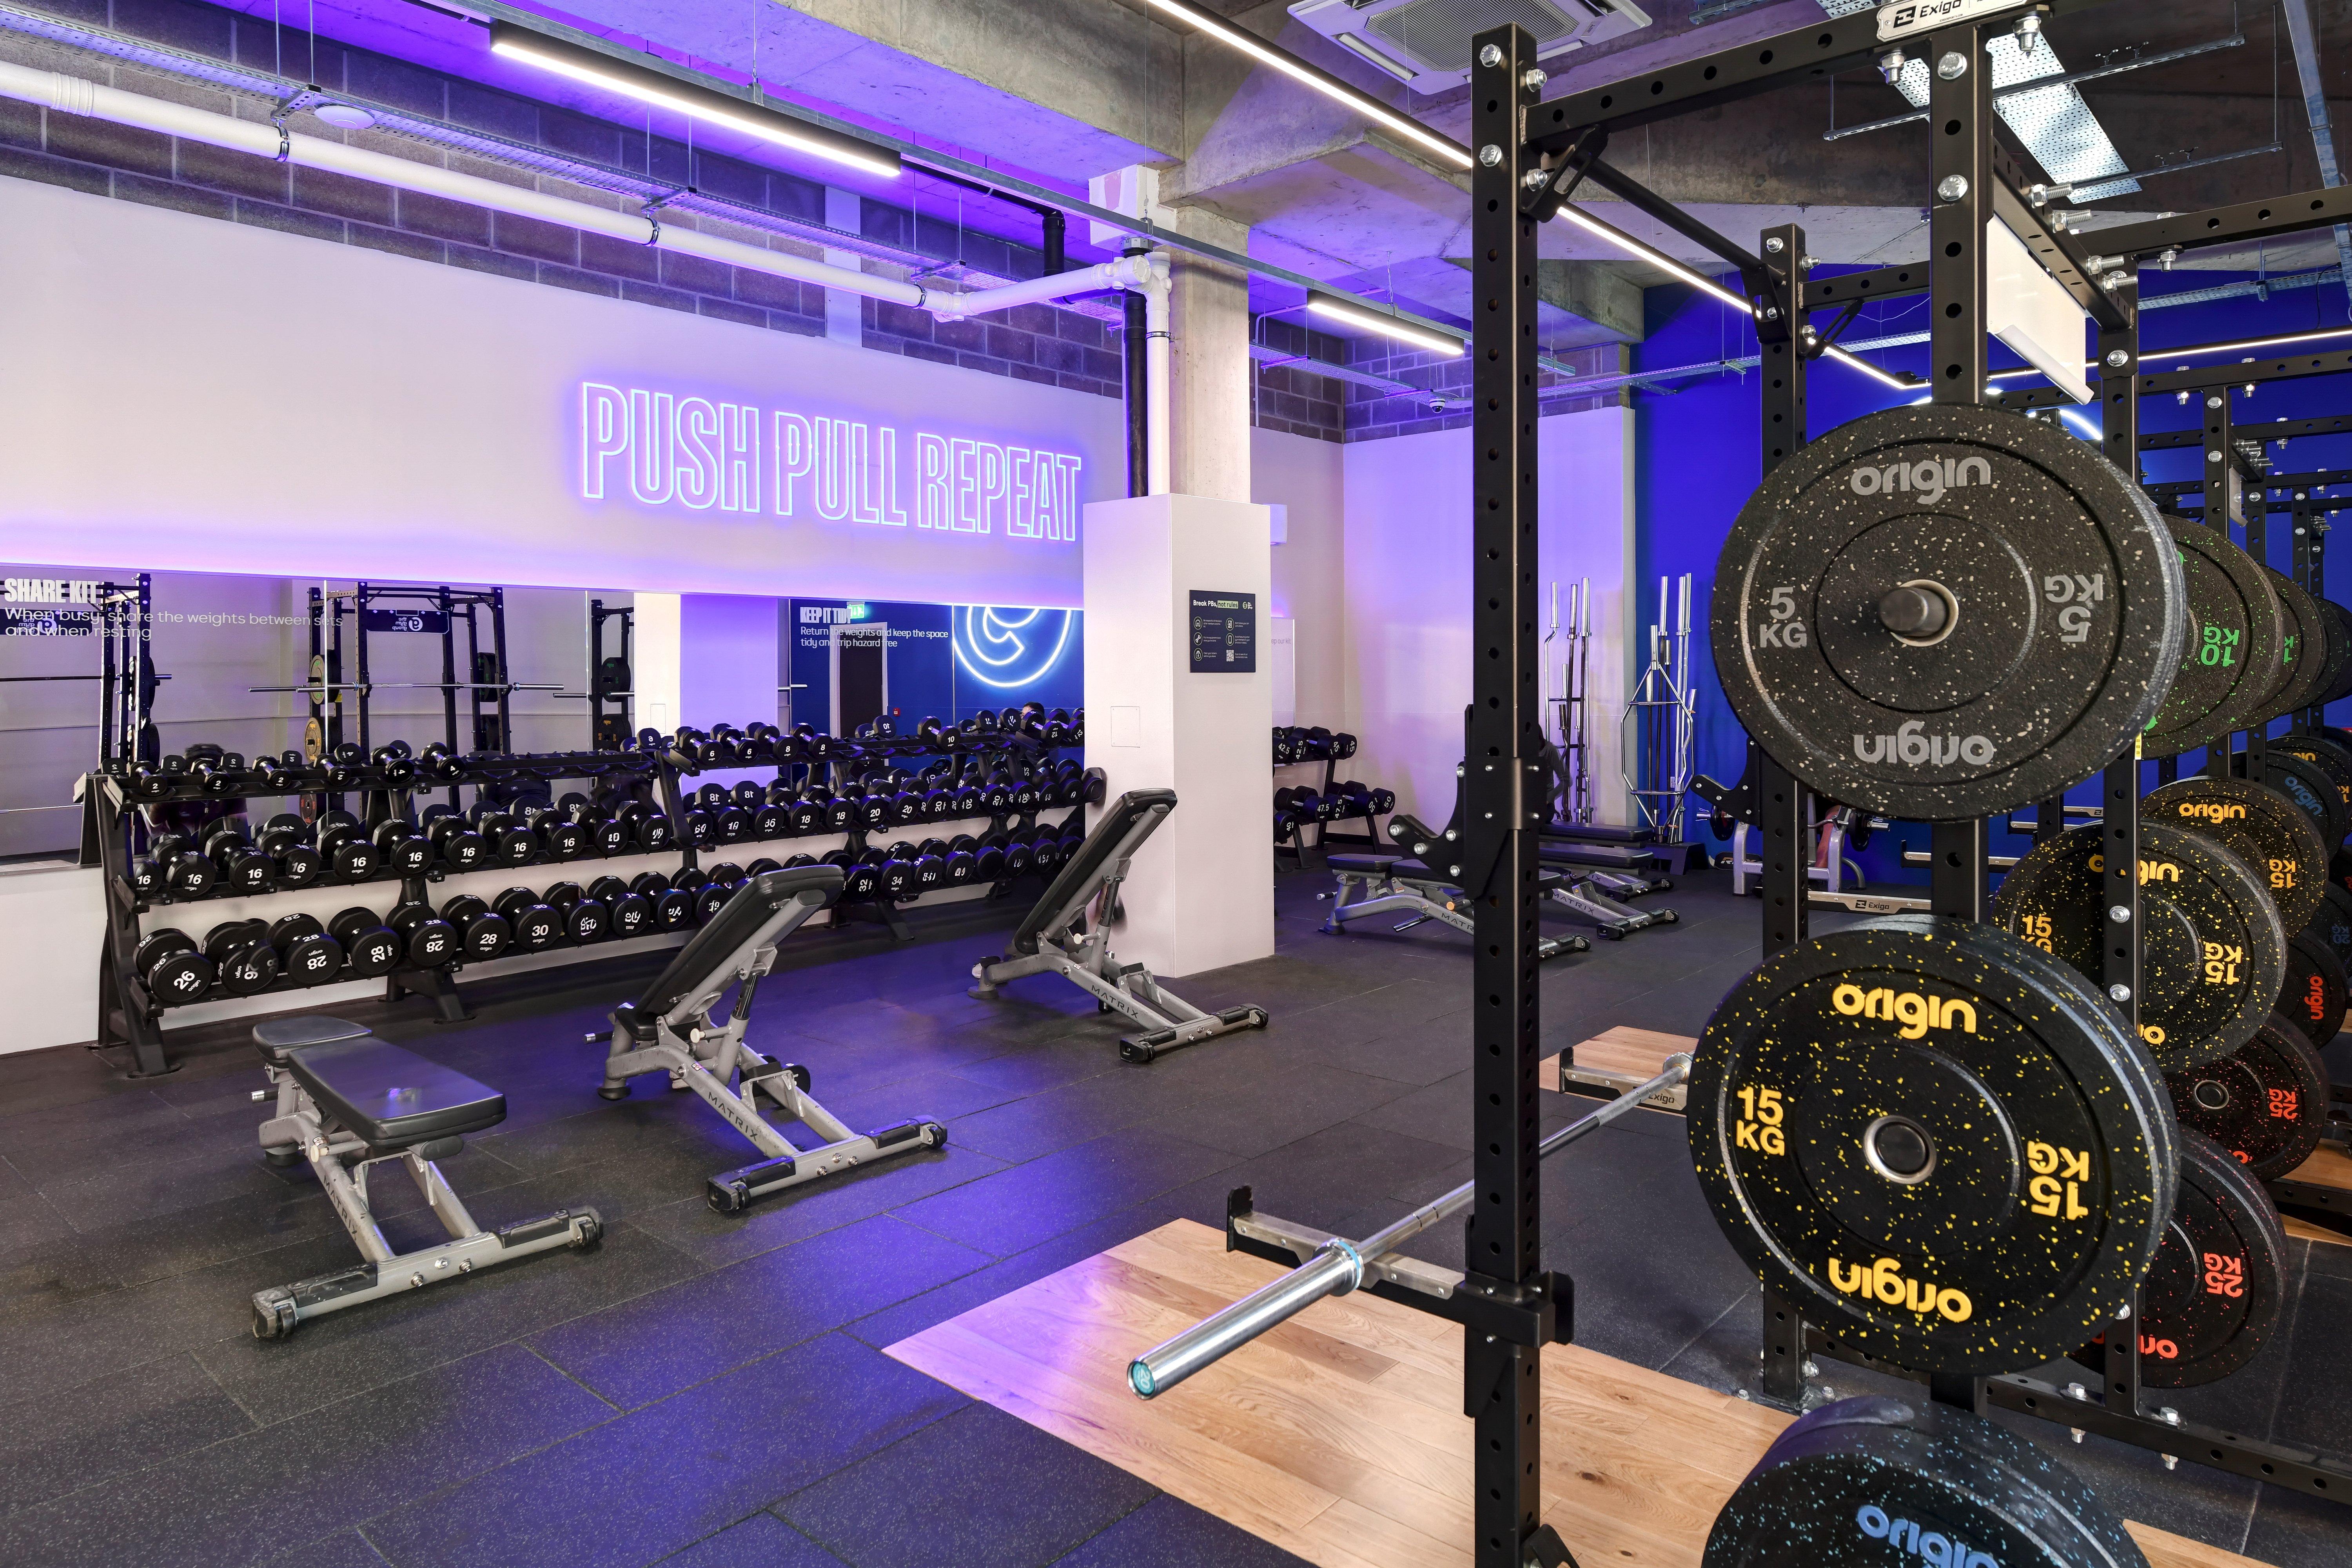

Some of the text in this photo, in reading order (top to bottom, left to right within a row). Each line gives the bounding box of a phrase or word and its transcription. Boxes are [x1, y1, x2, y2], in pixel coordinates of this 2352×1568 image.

[1920, 0, 1960, 18] Exigo
[582, 381, 1082, 542] PUSH PULL REPEAT
[1850, 456, 1992, 505] origin
[4, 578, 98, 604] SHARE KIT
[2044, 573, 2104, 604] KG
[1769, 586, 1795, 620] 5
[5, 607, 54, 620] When
[108, 610, 153, 622] share
[157, 611, 183, 623] the
[188, 612, 245, 626] weights
[249, 613, 310, 626] between
[314, 615, 343, 626] sets
[800, 607, 852, 624] KEEP IT TIDY
[2059, 604, 2092, 644] 5
[5, 625, 40, 637] and
[45, 625, 89, 637] when
[95, 627, 152, 641] resting
[801, 626, 949, 639] Return the weights and keep the space
[1759, 622, 1808, 649] KG
[2203, 626, 2240, 645] KG
[801, 638, 898, 649] tidy and trip hazard free
[2200, 644, 2236, 667] 10
[1278, 743, 1290, 754] 42.5
[1333, 741, 1340, 752] 45
[1350, 740, 1355, 752] 45
[1853, 720, 1995, 766] origin
[966, 799, 972, 809] 20
[980, 792, 986, 802] 20
[993, 795, 1000, 806] 20
[1009, 794, 1014, 803] 20
[1384, 796, 1391, 808] 50
[2285, 777, 2323, 816] origin
[870, 808, 880, 817] 20
[902, 805, 913, 814] 20
[921, 802, 926, 812] 20
[935, 801, 942, 812] 20
[952, 800, 957, 810] 20
[1317, 804, 1329, 812] 47.5
[1368, 801, 1375, 813] 50
[801, 815, 811, 823] 18
[836, 811, 846, 820] 18
[2178, 803, 2245, 824] origin
[1286, 822, 1291, 831] 40
[514, 842, 527, 852] 16
[563, 838, 575, 847] 16
[408, 852, 423, 862] 16
[462, 847, 475, 857] 16
[292, 862, 307, 873] 16
[352, 857, 367, 867] 16
[914, 857, 924, 866] 34
[2269, 858, 2296, 873] KG
[247, 868, 263, 879] 16
[2089, 854, 2179, 887] ogin
[137, 875, 151, 885] 16
[187, 873, 202, 884] 16
[858, 878, 868, 892] 32
[891, 876, 903, 886] 34
[2270, 872, 2296, 888] 15
[1553, 892, 1595, 916] MATRIX
[1868, 902, 1890, 911] Exigo
[532, 924, 549, 936] 30
[1442, 913, 1474, 932] MATR
[2022, 915, 2052, 937] 15
[302, 934, 320, 942] 28
[479, 933, 497, 944] 28
[426, 940, 445, 953] 28
[2205, 941, 2242, 964] KG
[370, 946, 386, 963] 28
[153, 958, 166, 972] 26
[218, 962, 224, 977] 26
[307, 955, 327, 970] 28
[173, 970, 195, 990] 26
[2204, 960, 2239, 985] 15
[188, 979, 201, 992] origin
[1091, 984, 1139, 1020] MATRIX
[2304, 975, 2324, 1020] origin
[1832, 984, 1976, 1040] origin
[2269, 1088, 2296, 1103] KG
[1737, 1087, 1784, 1127] 15
[2270, 1102, 2298, 1120] 25
[708, 1091, 758, 1142] MATRIX
[1736, 1117, 1786, 1157] KG
[2026, 1140, 2091, 1183] KG
[2028, 1176, 2090, 1220] 15
[323, 1175, 359, 1242] MATRIX
[2204, 1252, 2241, 1274] KG
[1828, 1256, 1973, 1323] origin
[2205, 1271, 2243, 1297] 25
[2141, 1334, 2178, 1359] ori
